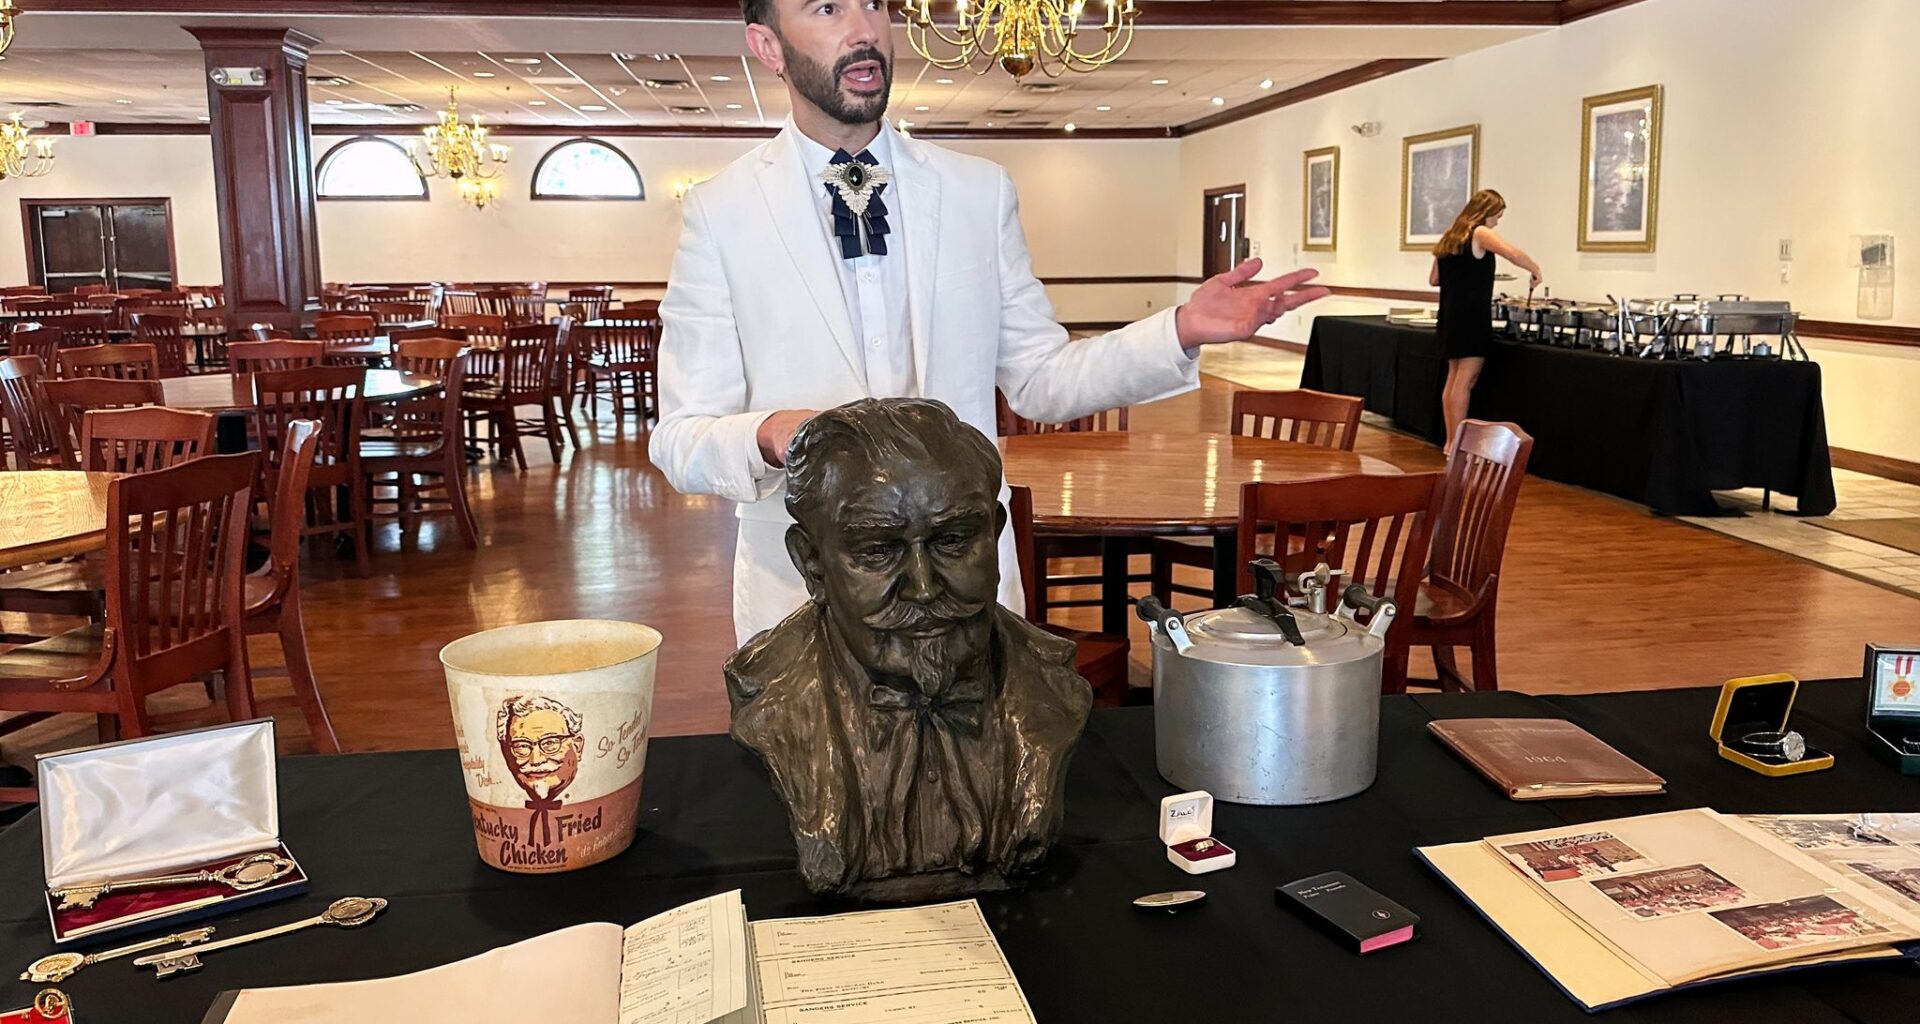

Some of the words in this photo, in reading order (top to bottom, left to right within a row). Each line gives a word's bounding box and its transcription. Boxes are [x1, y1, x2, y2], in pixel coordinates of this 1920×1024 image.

[597, 735, 615, 758] So
[616, 746, 631, 769] So
[555, 805, 602, 842] Fried
[500, 840, 568, 866] Chicken
[836, 1001, 868, 1009] SERVICE
